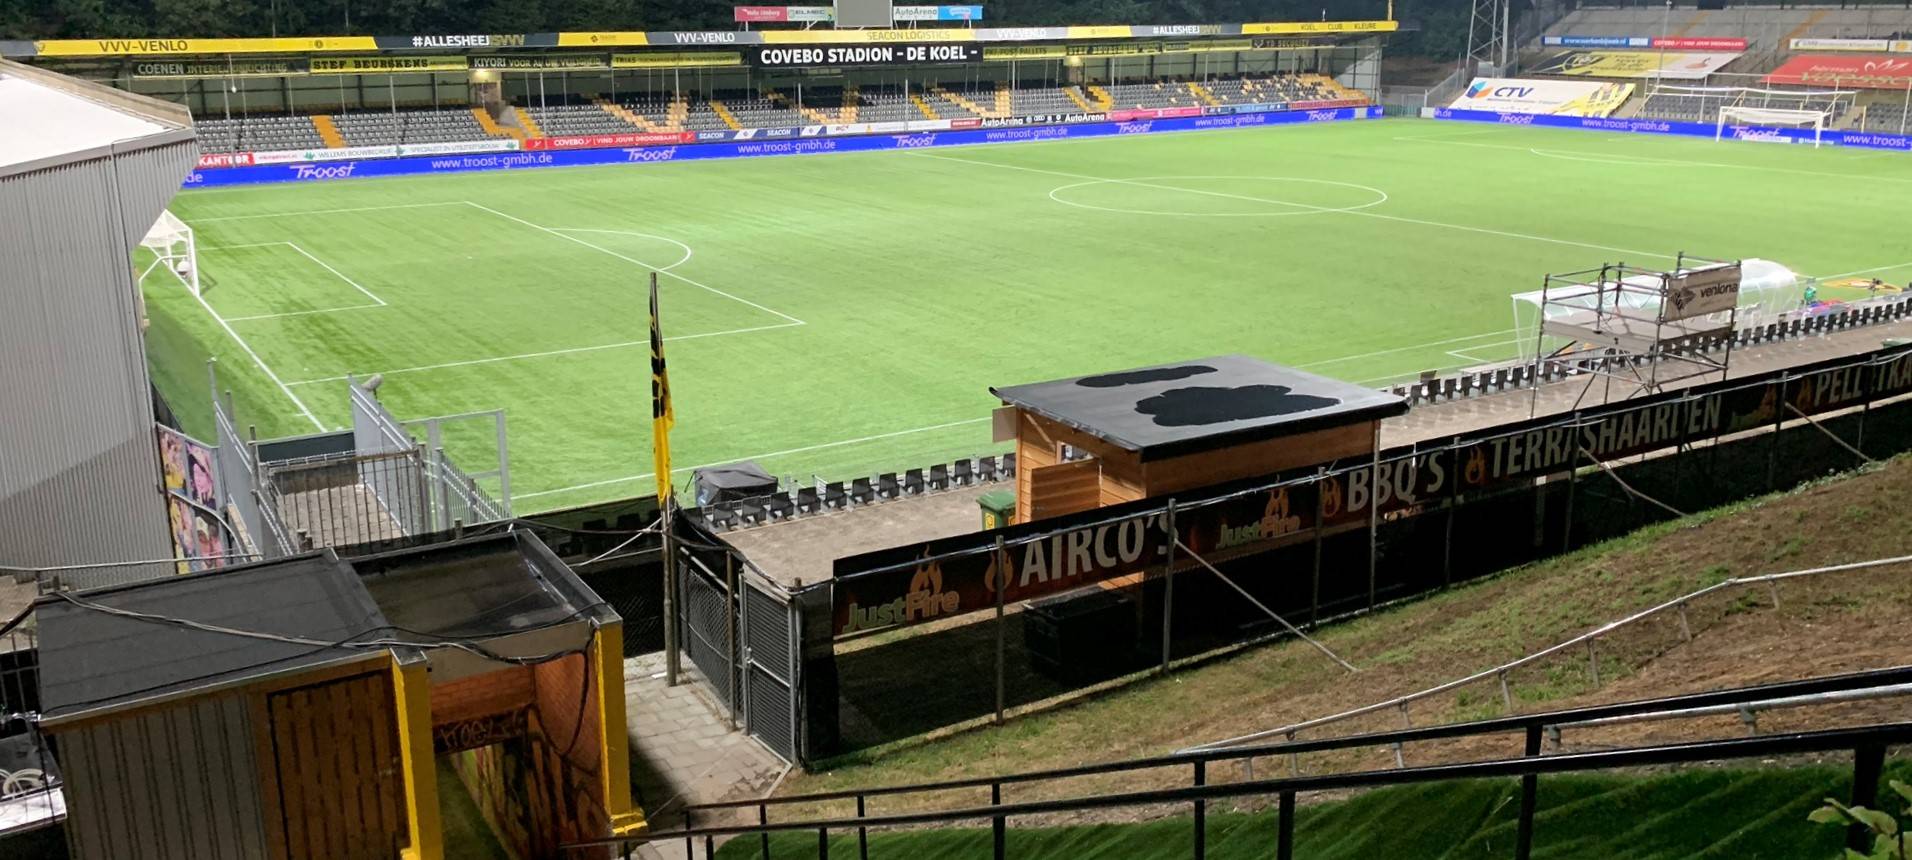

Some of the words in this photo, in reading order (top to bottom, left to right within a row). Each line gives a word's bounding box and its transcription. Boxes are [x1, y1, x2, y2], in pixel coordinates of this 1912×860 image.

[674, 31, 735, 44] VVV-VENLO
[866, 31, 903, 42] SEACON
[905, 30, 950, 41] LOGISTICS
[100, 40, 188, 52] VVV-VENLO
[761, 49, 823, 64] COVEBO
[827, 48, 892, 62] STADION
[907, 48, 926, 60] DE
[930, 46, 968, 60] KOEL
[312, 60, 345, 70] STEF
[354, 57, 428, 69] BEURSKENS
[474, 58, 506, 67] KIYORI
[137, 63, 184, 75] COENEN
[1493, 87, 1534, 97] CTV
[1064, 112, 1105, 123] AutoArena
[1305, 108, 1338, 119] Troost
[1495, 112, 1535, 124] Troost
[1195, 115, 1265, 127] www.troost-gmbh.de
[1582, 119, 1670, 131] www.troost-gmbh.de
[767, 128, 791, 136] SEACON
[1116, 122, 1153, 133] Troost
[699, 131, 725, 139] SEACON
[986, 128, 1068, 140] www.troost-gmbh.de
[554, 139, 585, 147] COVEBO
[891, 134, 937, 147] Troost
[737, 140, 836, 154] www.troost-gmbh.de
[622, 147, 680, 161] Troost
[431, 153, 553, 168] www.troost-gmbh.de
[289, 162, 357, 179] Troost
[1701, 283, 1738, 298] venlona
[842, 590, 960, 633] JustFire
